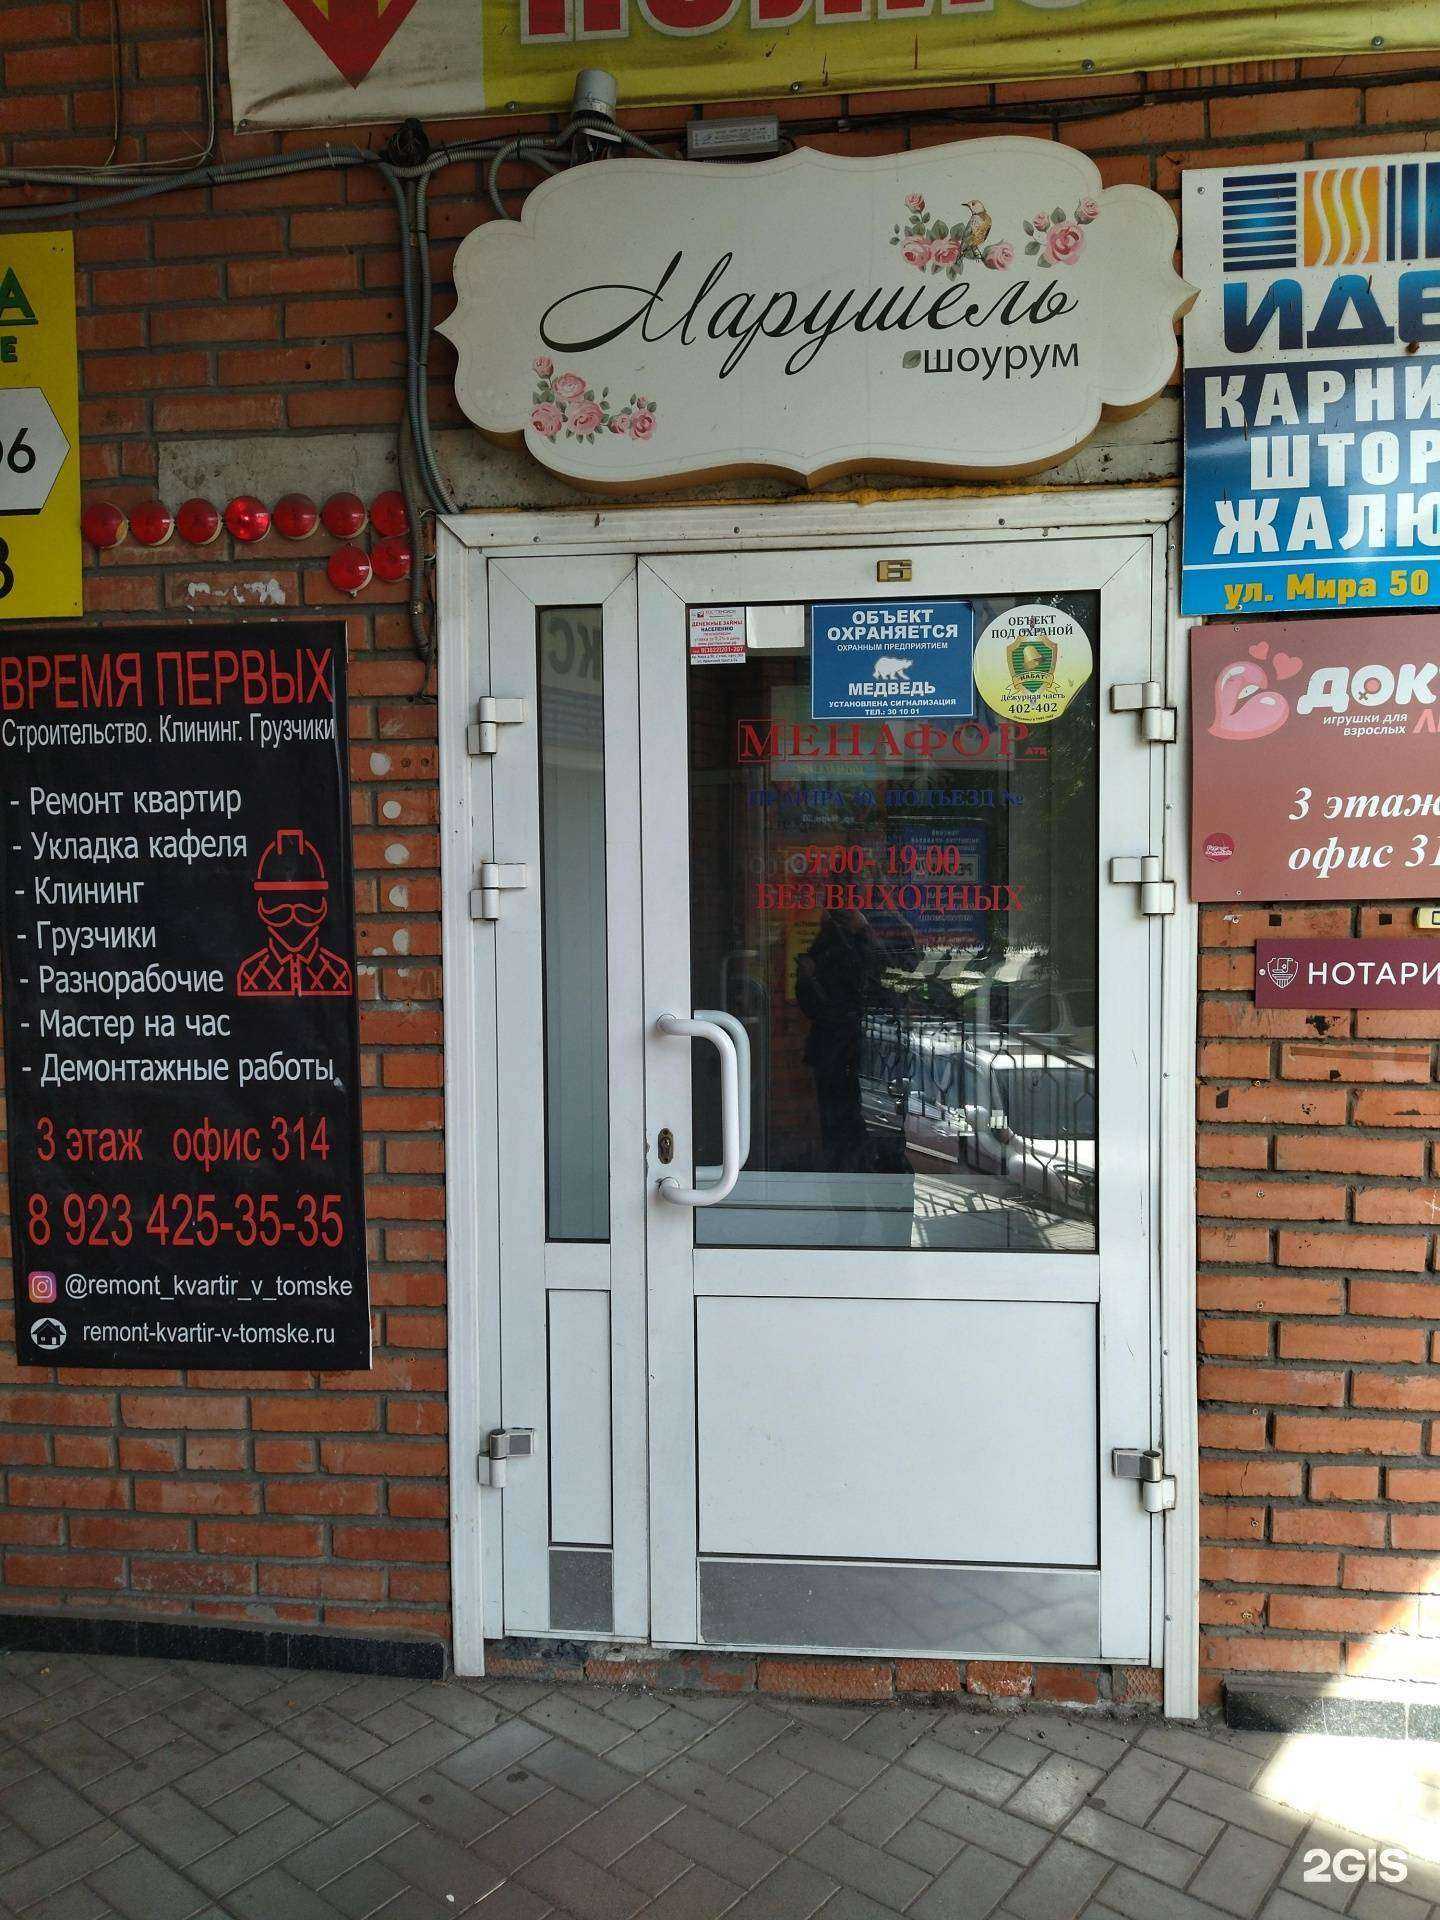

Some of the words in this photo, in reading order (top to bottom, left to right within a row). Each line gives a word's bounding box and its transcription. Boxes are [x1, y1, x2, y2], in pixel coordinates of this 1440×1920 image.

[539, 250, 1079, 379] Марушель
[1223, 273, 1440, 353] ИДЕ
[922, 342, 1080, 380] шоурум
[1204, 364, 1440, 429] КАРНИ
[0, 428, 36, 473] 6
[1250, 429, 1440, 491] ШТОР
[1213, 491, 1440, 555] ЖАЛЮ
[1224, 582, 1274, 610] ул.
[1287, 572, 1377, 606] Мира
[1389, 569, 1429, 596] 50
[827, 624, 959, 641] ОХРАНЯЕТСЯ
[852, 609, 934, 625] ОБЪЕКТ
[991, 629, 1016, 640] ПОД
[1018, 624, 1074, 637] ОХРАНОЙ
[837, 644, 883, 652] ОХРАННЫМ
[884, 642, 948, 651] ПРЕДПРИЯТИЕМ
[1, 653, 144, 710] ВРЕМЯ
[156, 648, 333, 706] ПЕРВЫХ
[848, 681, 936, 698] МЕДВЕДЬ
[1297, 664, 1440, 714] ДОК
[828, 701, 889, 709] УСТАНОВЛЕНА
[890, 699, 956, 708] СИГНАЛИЗАЦИЯ
[1001, 694, 1041, 703] Дежурная
[1042, 692, 1066, 700] часть
[1008, 703, 1058, 714] 402-402
[2, 718, 152, 752] Строительство.
[159, 714, 243, 743] Клининг.
[249, 713, 336, 748] Грузчики
[1323, 714, 1380, 727] игрушки
[1383, 712, 1408, 723] для
[1343, 725, 1407, 738] взрослых
[1412, 708, 1440, 734] Л
[740, 724, 1030, 758] МЕНАФОР
[30, 787, 123, 815] Ремонт
[134, 789, 242, 819] квартир
[1288, 787, 1312, 821] 3
[1323, 794, 1440, 819] этаж
[31, 831, 139, 862] Укладка
[149, 829, 248, 864] кафеля
[1288, 837, 1394, 879] офис
[34, 876, 144, 905] Клининг
[755, 884, 815, 911] БЕЗ
[825, 884, 1024, 914] ВЫХОДНЫХ
[36, 921, 156, 955] Грузчики
[39, 963, 224, 1000] Разнорабочие
[1308, 962, 1440, 985] НОТАРИ
[40, 1009, 135, 1043] Мастер
[145, 1013, 175, 1036] на
[186, 1013, 231, 1037] час
[40, 1053, 229, 1087] Демонтажные
[238, 1051, 334, 1087] работы
[36, 1116, 56, 1161] 3
[67, 1128, 143, 1162] этаж
[173, 1117, 261, 1172] офис
[271, 1116, 330, 1161] 314
[28, 1194, 51, 1246] 8
[63, 1193, 134, 1247] 923
[146, 1193, 344, 1247] 425-35-35
[65, 1273, 353, 1301] @remont_kvartir_v_tomske
[83, 1322, 335, 1344] remont-kvartir-v-tomske.ru
